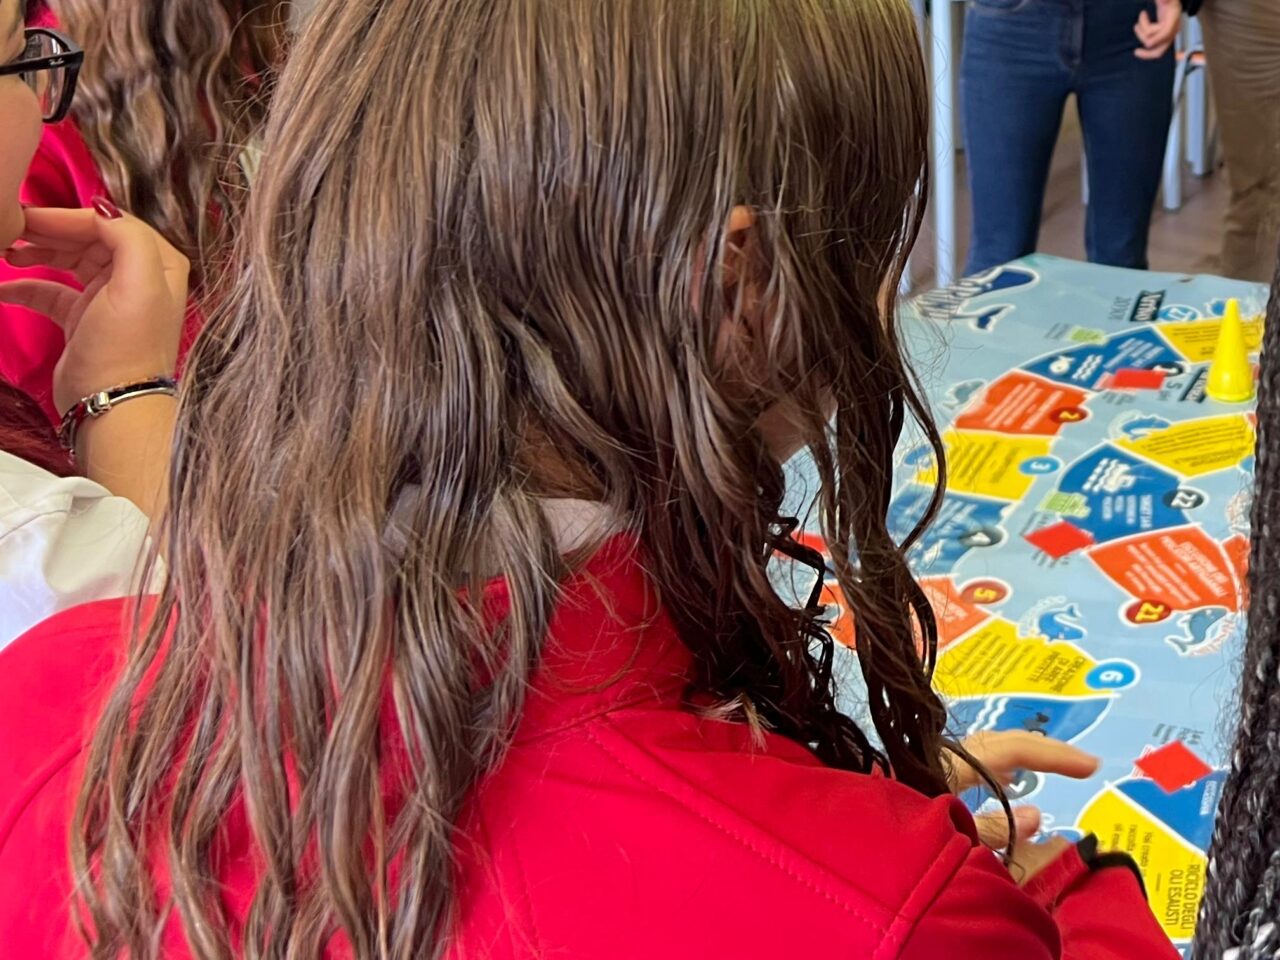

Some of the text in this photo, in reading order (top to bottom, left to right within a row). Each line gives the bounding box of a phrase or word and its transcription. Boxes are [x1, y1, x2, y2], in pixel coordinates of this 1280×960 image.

[1029, 461, 1052, 471] 3
[1170, 490, 1198, 508] 22
[974, 587, 998, 601] 5
[1134, 602, 1165, 621] 21
[1098, 669, 1124, 684] 6
[1165, 869, 1185, 926] OLI ESAUSTI
[1180, 864, 1201, 930] RICICLO DEGLI
